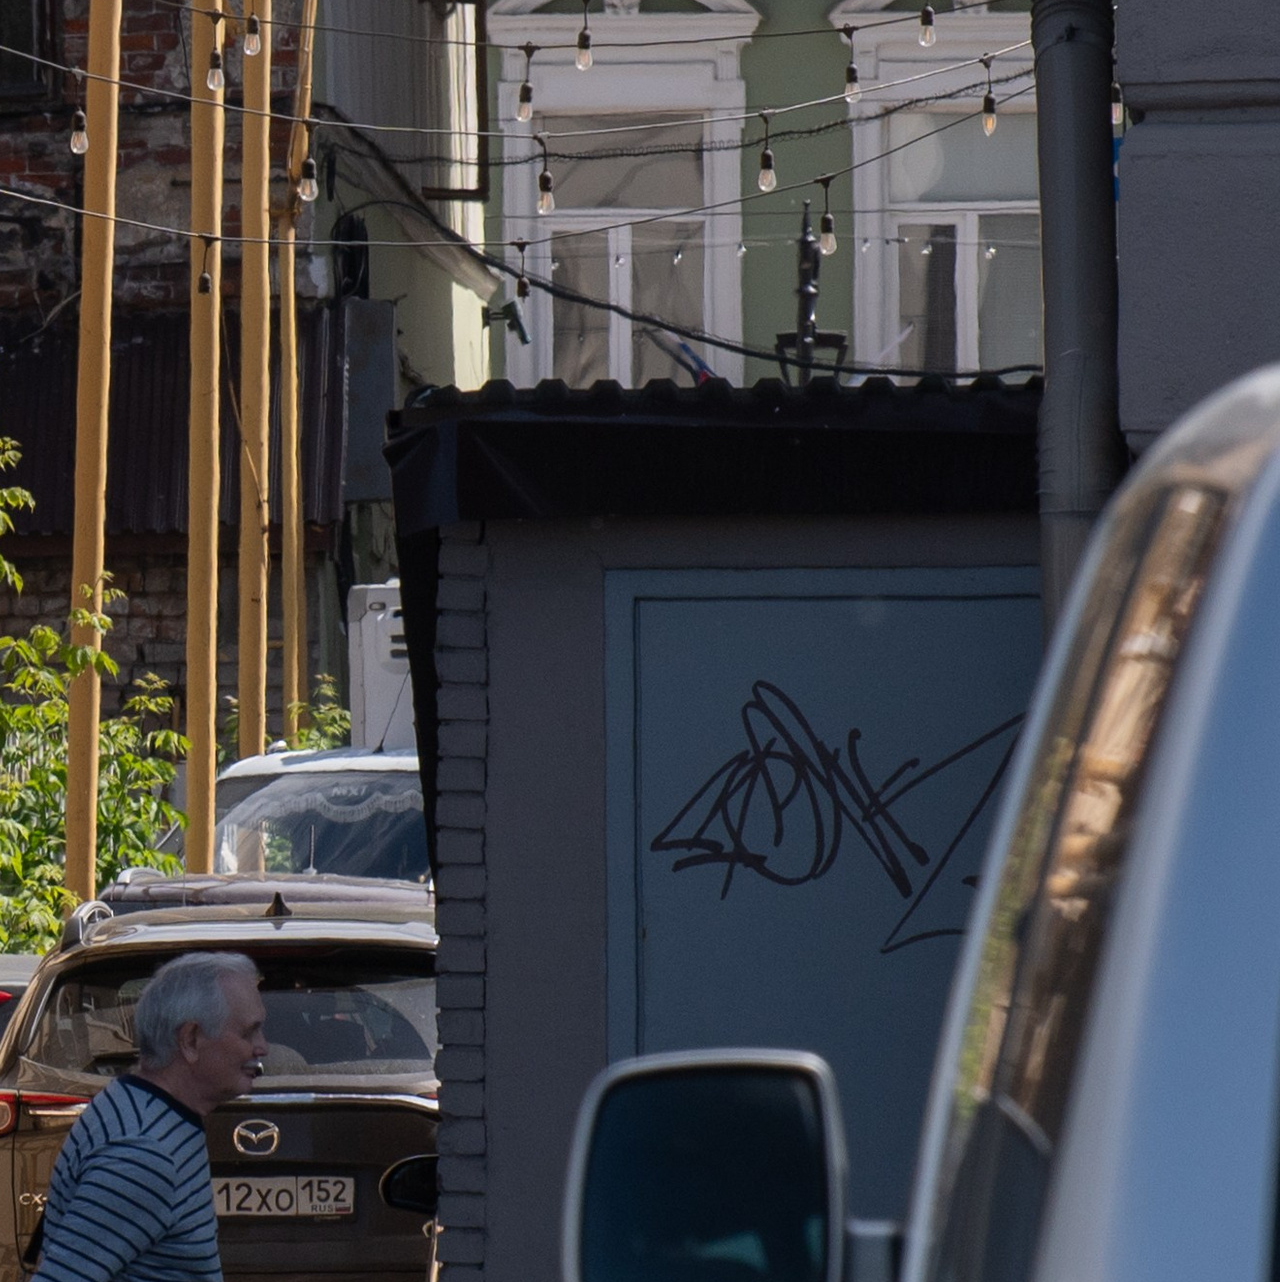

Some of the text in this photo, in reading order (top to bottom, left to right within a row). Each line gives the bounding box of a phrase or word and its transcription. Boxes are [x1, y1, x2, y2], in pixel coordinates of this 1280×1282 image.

[18, 1192, 48, 1206] CX-
[217, 1179, 346, 1213] 12ХО 152
[310, 1203, 334, 1213] RUS
